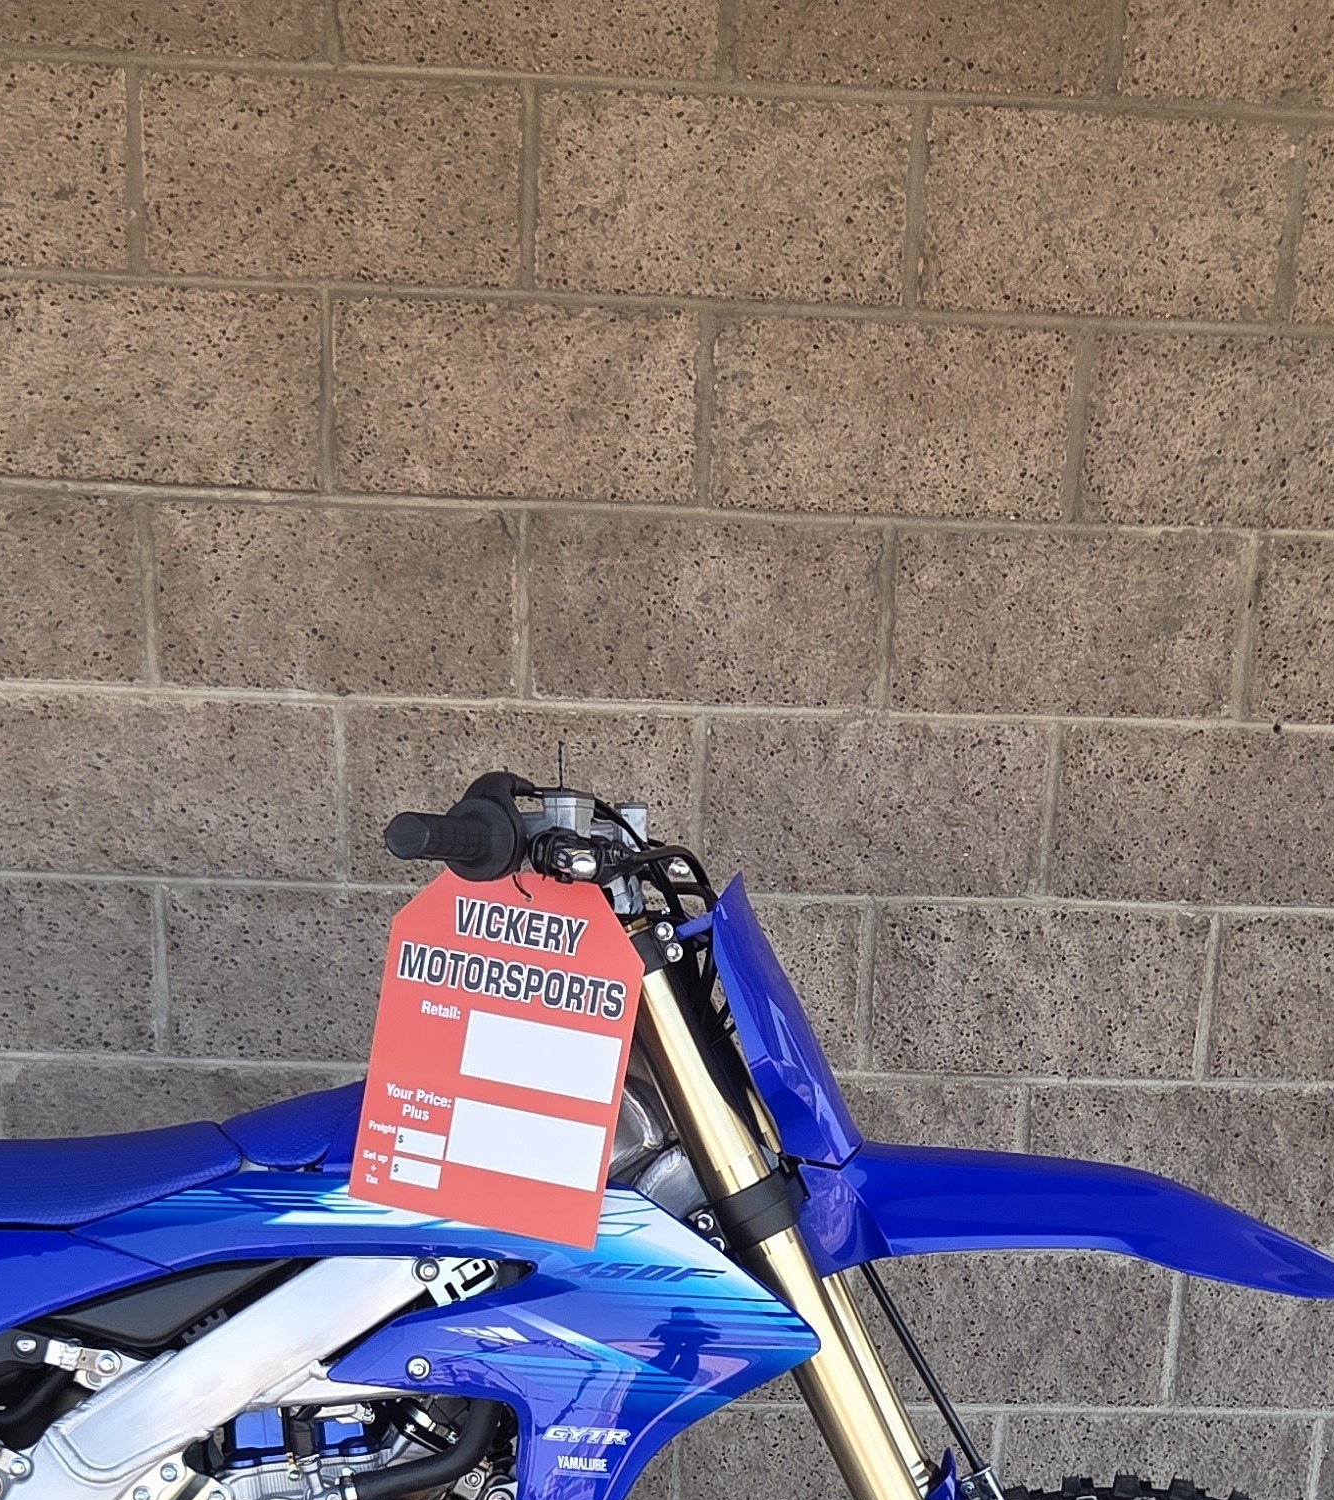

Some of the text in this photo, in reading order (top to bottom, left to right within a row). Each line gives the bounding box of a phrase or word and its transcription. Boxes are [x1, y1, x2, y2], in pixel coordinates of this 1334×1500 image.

[455, 896, 588, 956] VICKERY
[397, 941, 627, 1020] MOTORSPORTS
[421, 1000, 461, 1020] Retail:
[386, 1083, 452, 1108] Your Price:
[402, 1104, 430, 1121] Plus
[368, 1120, 397, 1135] Freight
[362, 1149, 377, 1161] Set
[377, 1154, 389, 1164] up
[365, 1173, 379, 1185] Tax
[555, 1261, 727, 1282] 450F
[542, 1425, 631, 1445] GYTR
[557, 1455, 608, 1472] YAMALUBE
